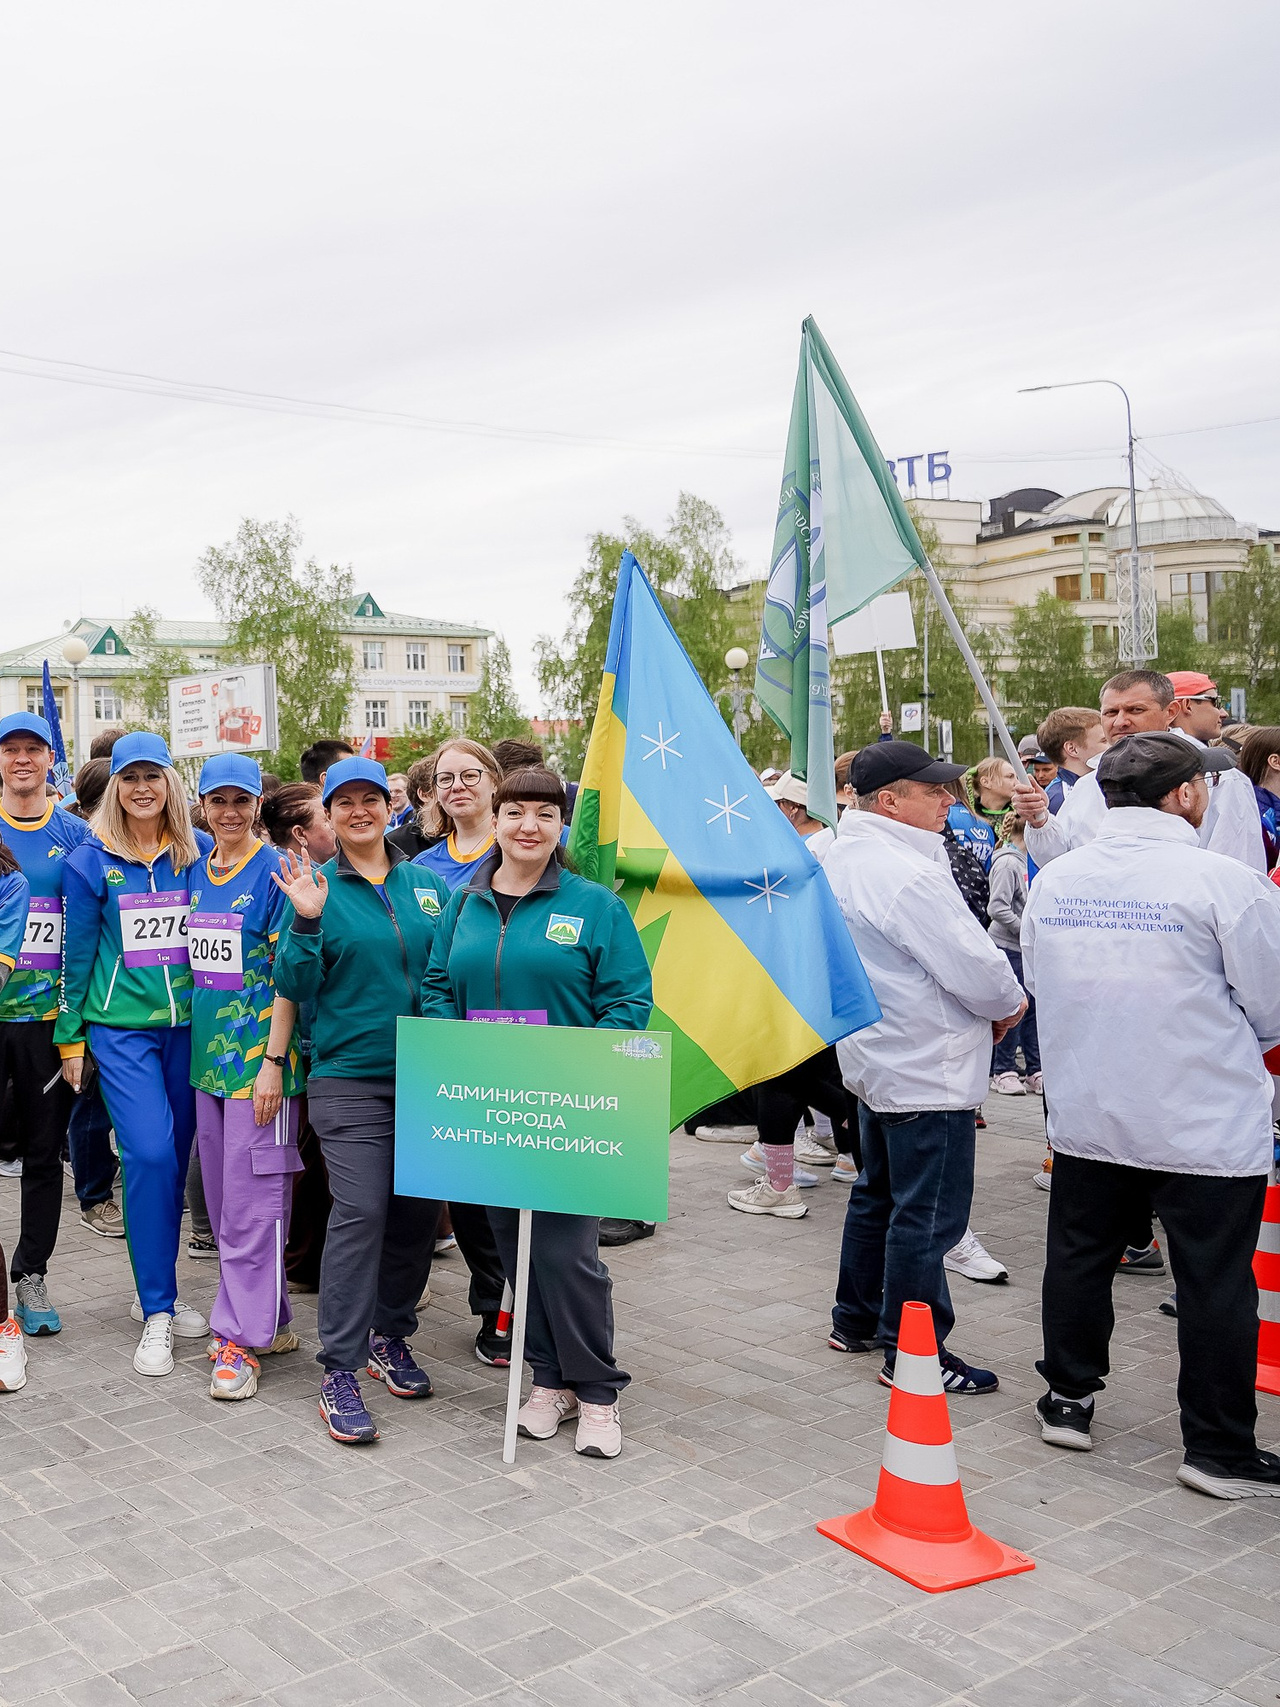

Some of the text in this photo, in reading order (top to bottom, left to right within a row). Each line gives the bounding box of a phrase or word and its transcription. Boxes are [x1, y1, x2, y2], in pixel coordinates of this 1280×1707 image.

[1054, 897, 1169, 911] ХАНТЫ-МАНСИЙСКАЯ
[1058, 908, 1161, 921] ГОСУДАРСТВЕННАЯ
[23, 921, 55, 943] 72
[134, 914, 188, 940] 2276
[1039, 917, 1184, 933] МЕДИЦИНСКАЯ АКАДЕМИЯ
[191, 938, 232, 961] 2065
[436, 1083, 619, 1111] АДМИНИСТРАЦИЯ
[486, 1109, 567, 1130] ГОРОДА
[431, 1125, 624, 1156] ХАНТЫ-МАНСИЙСК
